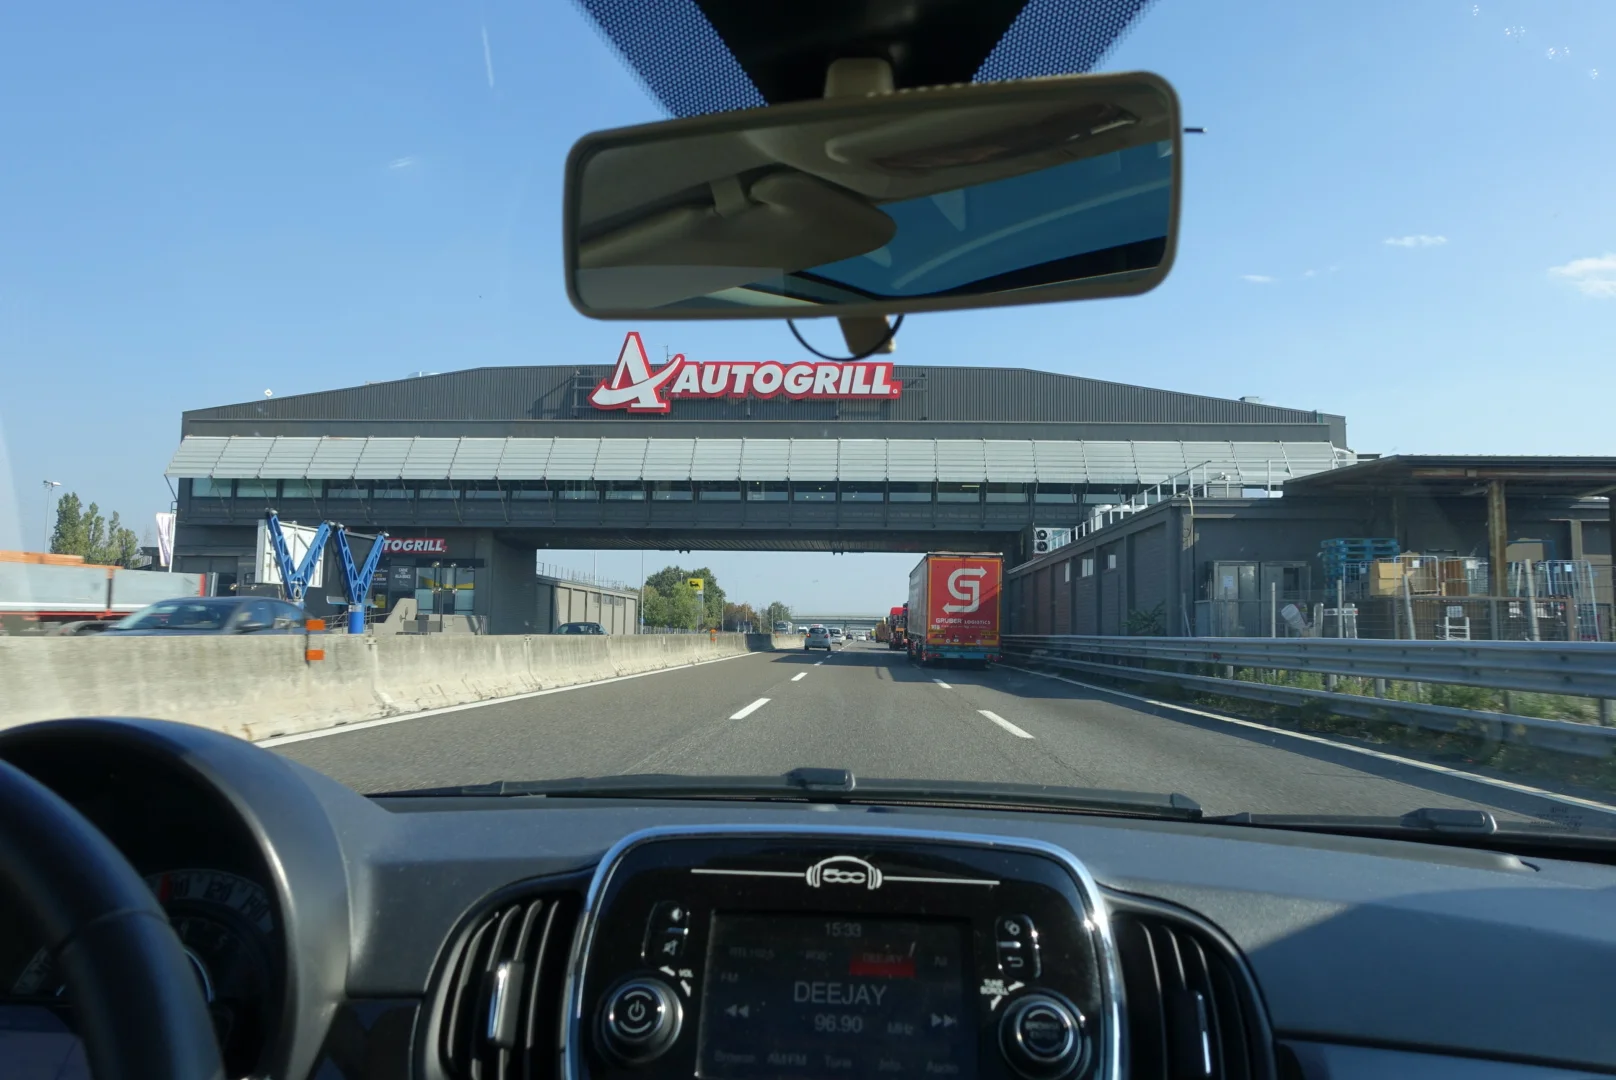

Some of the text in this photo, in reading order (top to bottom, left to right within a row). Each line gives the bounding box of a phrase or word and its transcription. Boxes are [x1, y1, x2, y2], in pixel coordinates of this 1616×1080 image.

[671, 364, 892, 394] AUTOGRILL
[383, 539, 445, 552] TOGRILL
[822, 868, 866, 884] 500
[793, 980, 887, 1006] DEEJAY
[814, 1014, 864, 1034] 96.90
